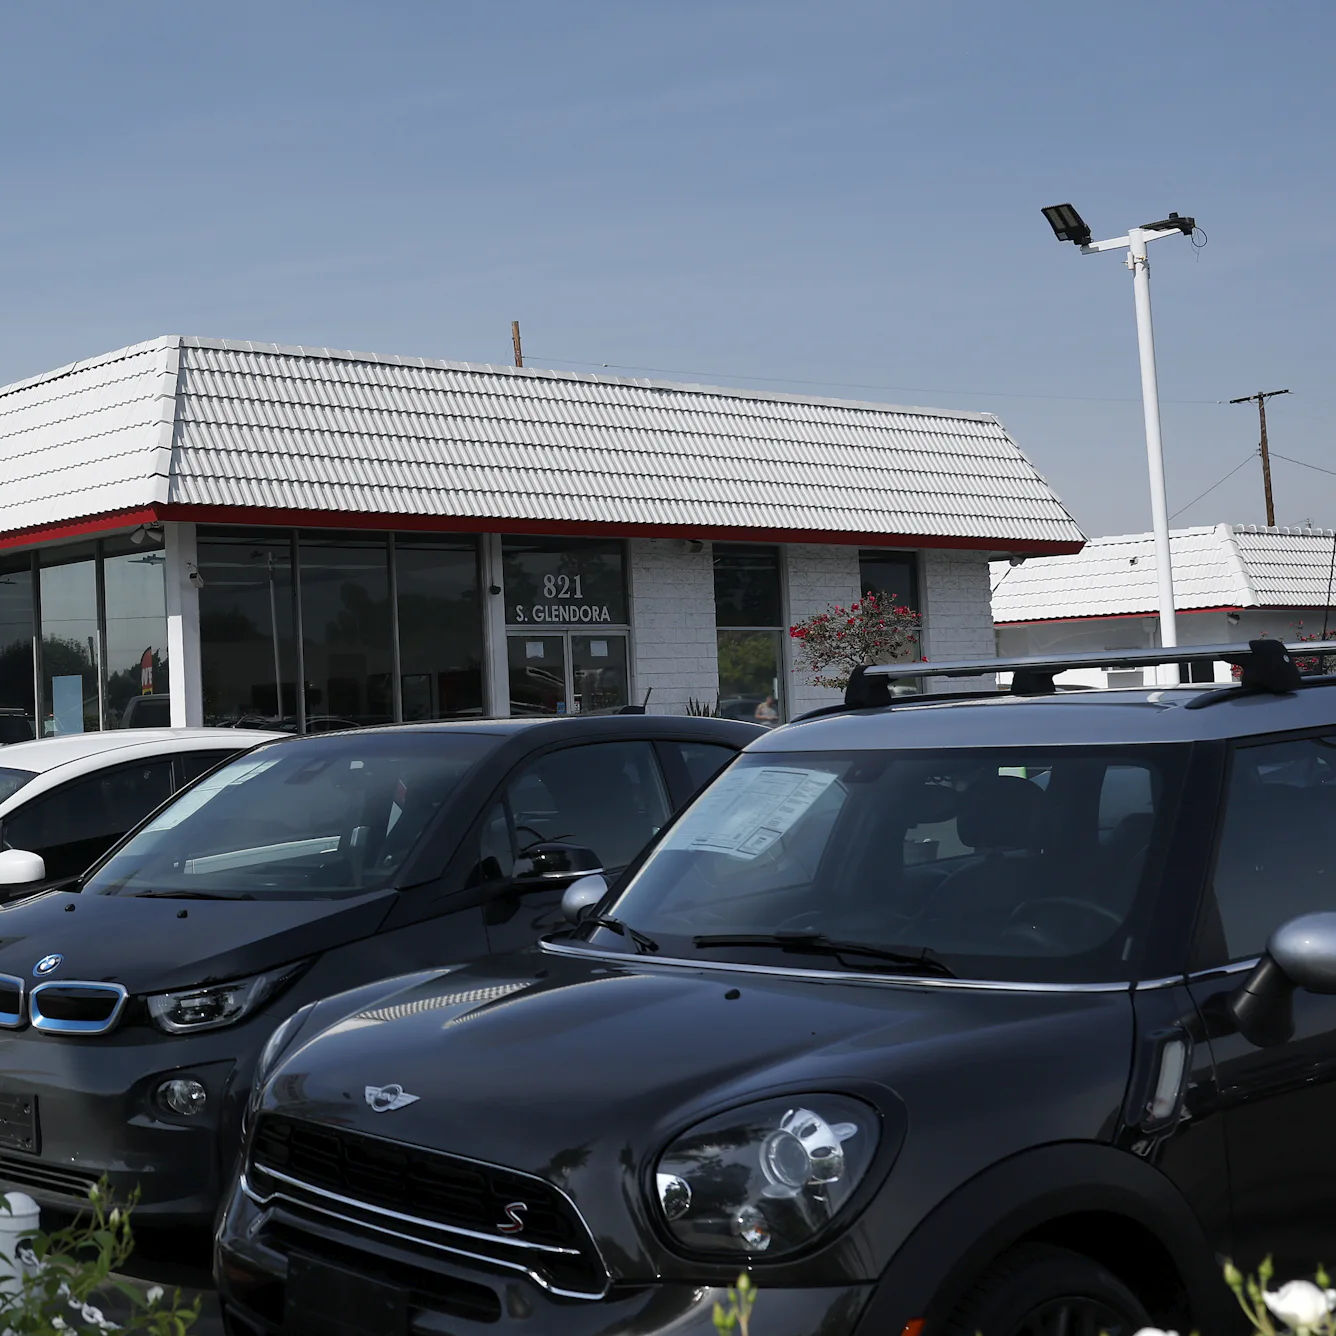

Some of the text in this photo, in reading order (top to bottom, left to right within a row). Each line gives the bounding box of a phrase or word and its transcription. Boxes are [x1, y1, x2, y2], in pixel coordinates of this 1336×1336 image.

[543, 574, 584, 599] 821
[515, 605, 611, 622] S. GLENDORA
